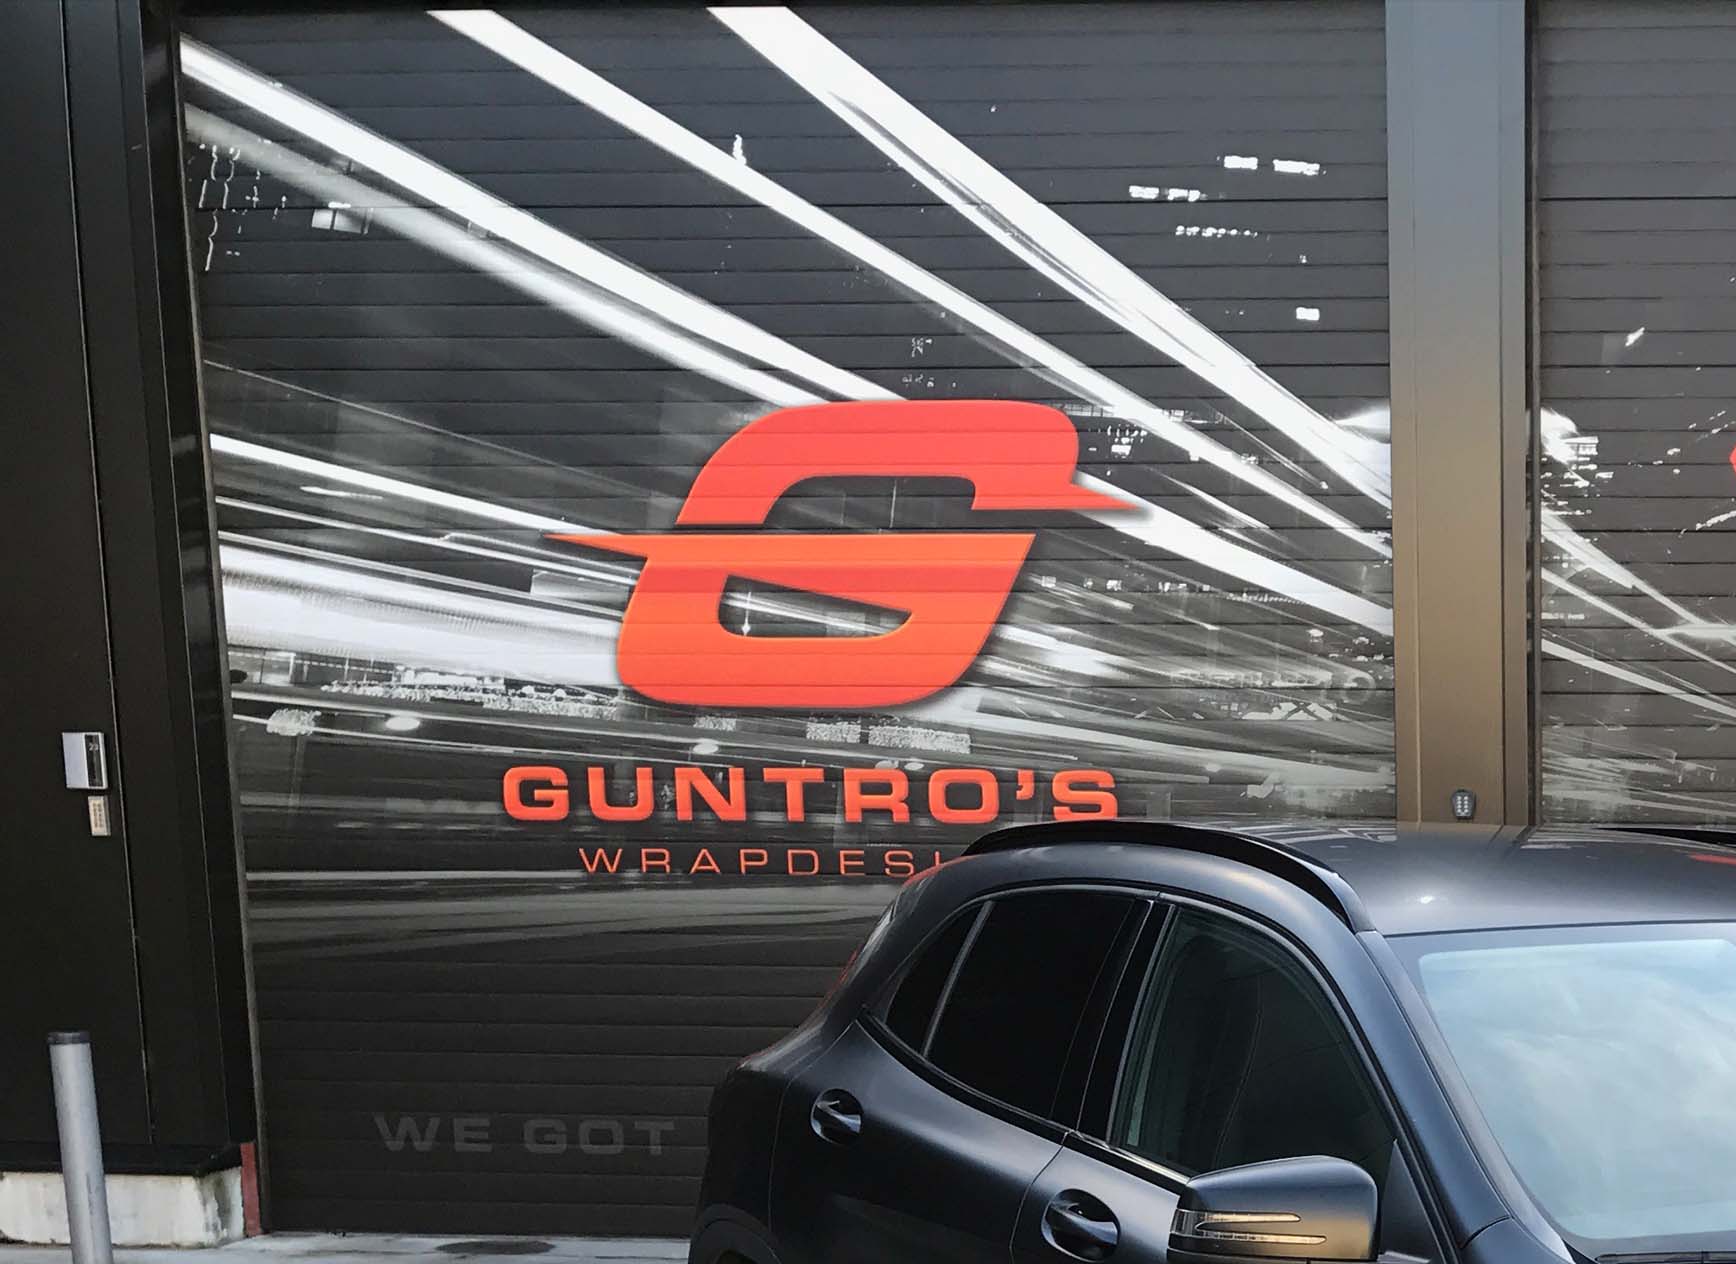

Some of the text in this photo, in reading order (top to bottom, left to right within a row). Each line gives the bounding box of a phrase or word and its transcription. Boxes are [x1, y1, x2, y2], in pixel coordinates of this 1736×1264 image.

[501, 764, 1119, 825] GUNTRO'S
[372, 1115, 676, 1155] WE GOT
